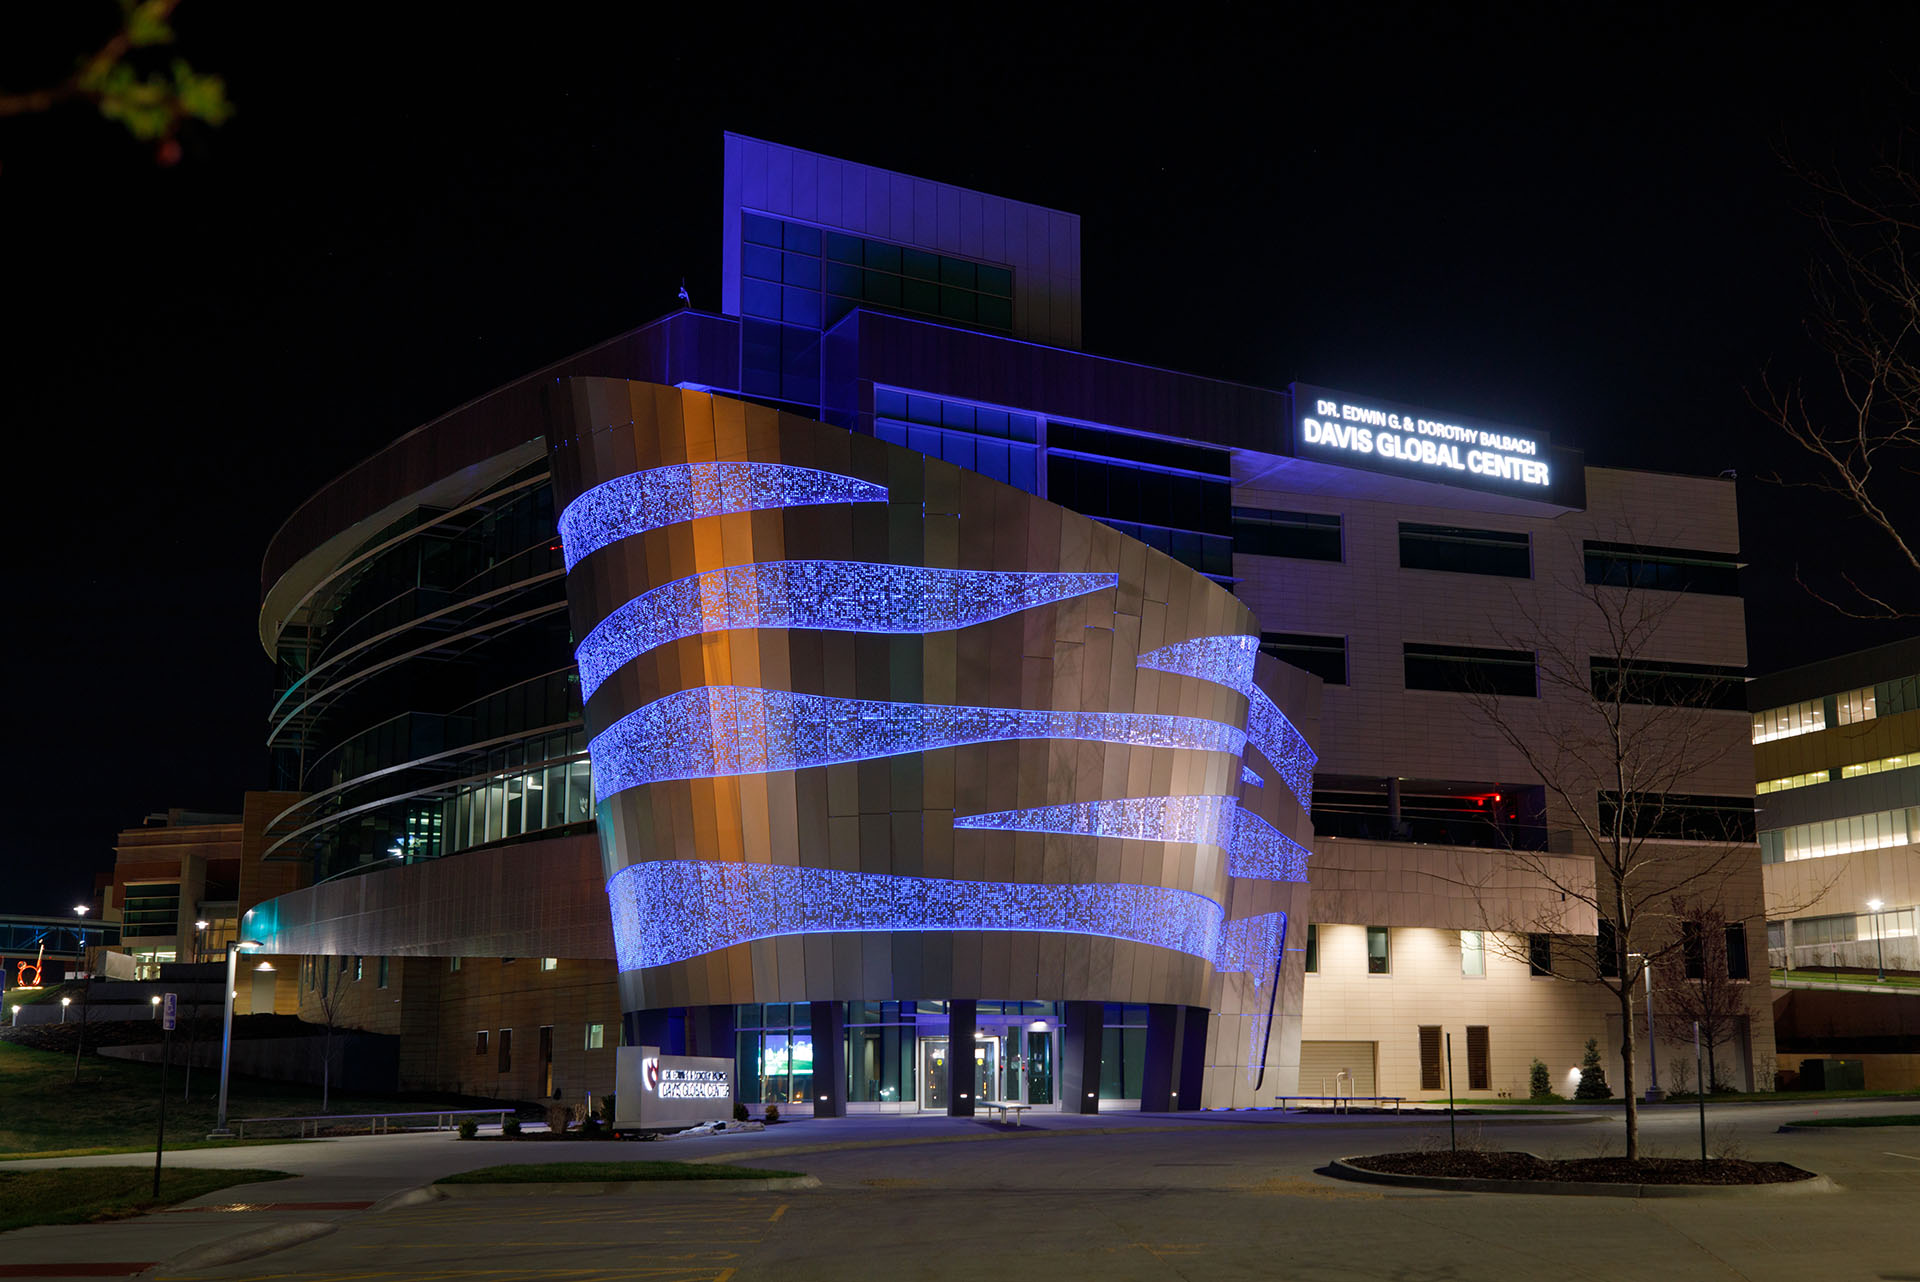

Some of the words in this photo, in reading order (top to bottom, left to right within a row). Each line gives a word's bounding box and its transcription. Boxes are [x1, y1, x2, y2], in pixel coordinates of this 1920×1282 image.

[1303, 418, 1374, 454] DAVIS
[1376, 432, 1466, 471] GLOBAL
[1467, 449, 1550, 486] CENTER
[1317, 399, 1341, 418] DR.
[1342, 404, 1387, 427] EDWIN
[1388, 413, 1402, 430] G.
[1403, 416, 1416, 433] &
[1417, 419, 1479, 444] DOROTHY
[1479, 431, 1536, 456] BALBACH
